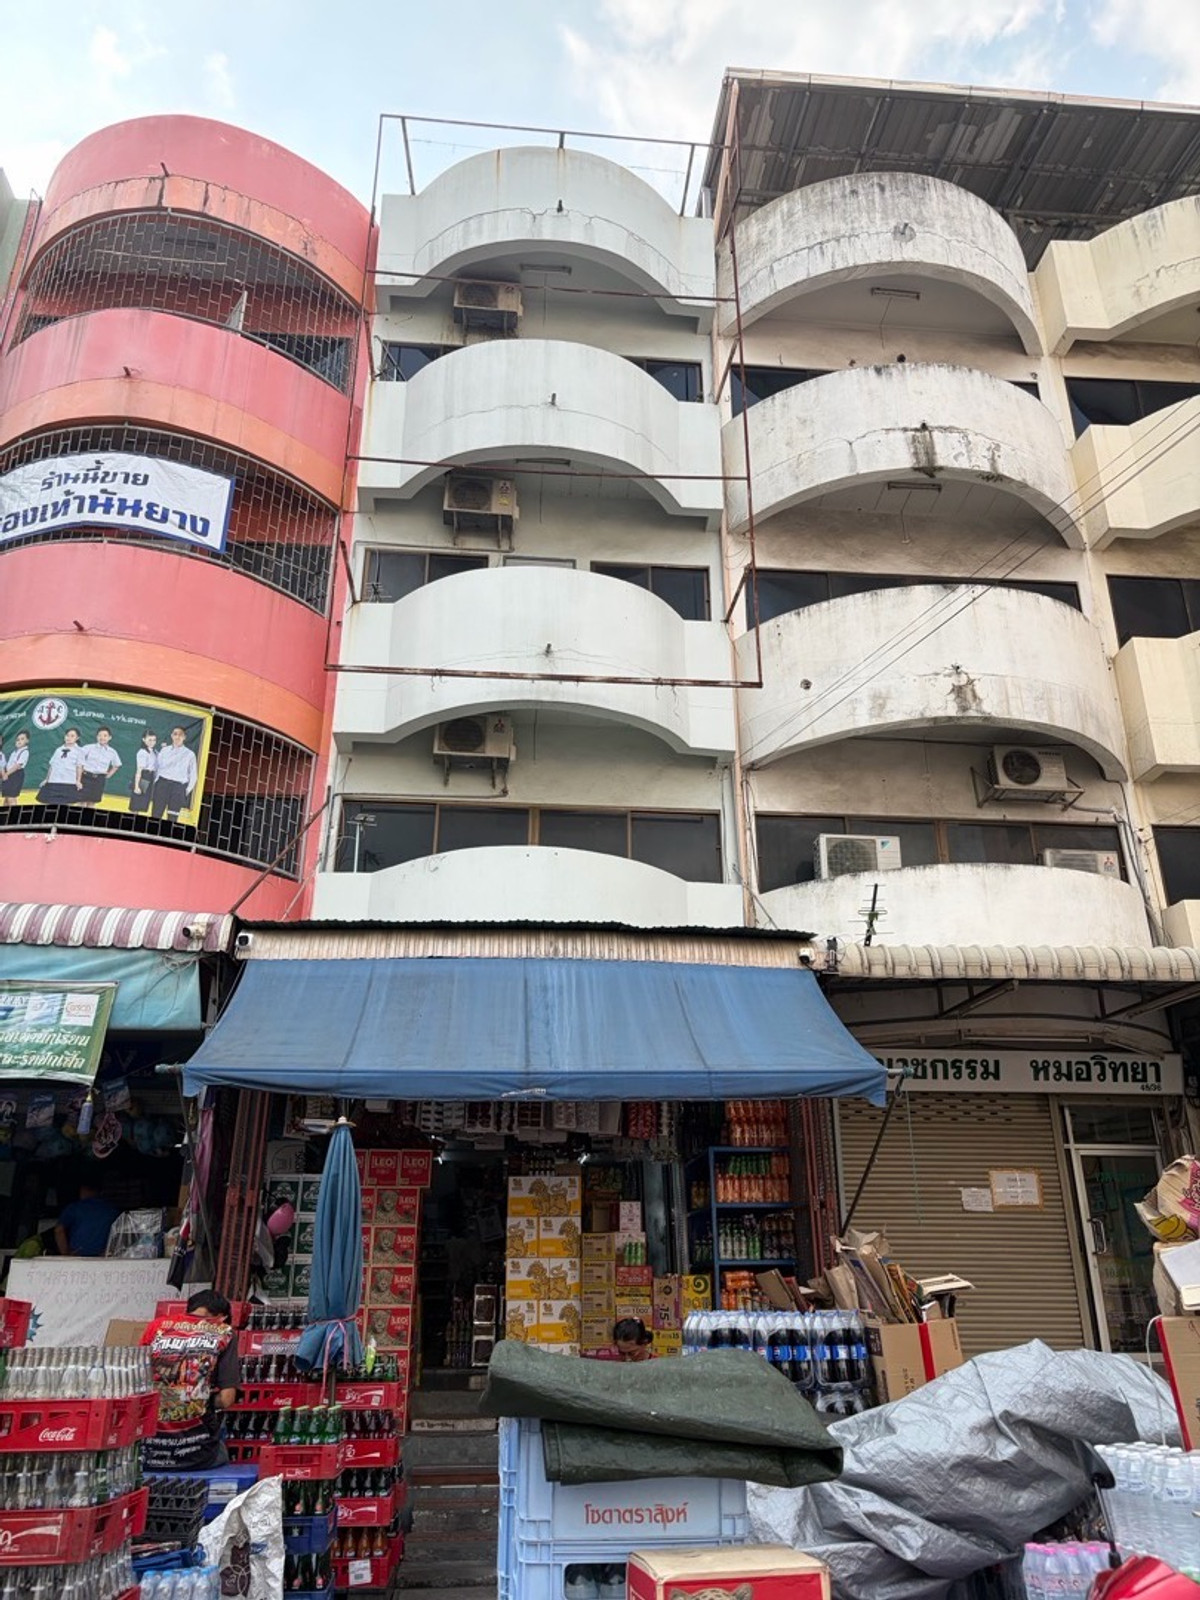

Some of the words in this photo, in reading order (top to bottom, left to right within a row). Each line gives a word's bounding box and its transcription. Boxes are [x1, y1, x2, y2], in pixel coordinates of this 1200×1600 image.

[40, 459, 150, 491] ร้านนี้ขาย
[0, 488, 211, 538] องเท้านันยาง
[876, 1056, 1001, 1081] เวชกรรม
[1029, 1054, 1162, 1083] หมอวิทยา
[375, 1157, 393, 1167] LEO
[406, 1157, 425, 1167] LEO
[584, 1501, 689, 1526] โซดาตราสิงห์
